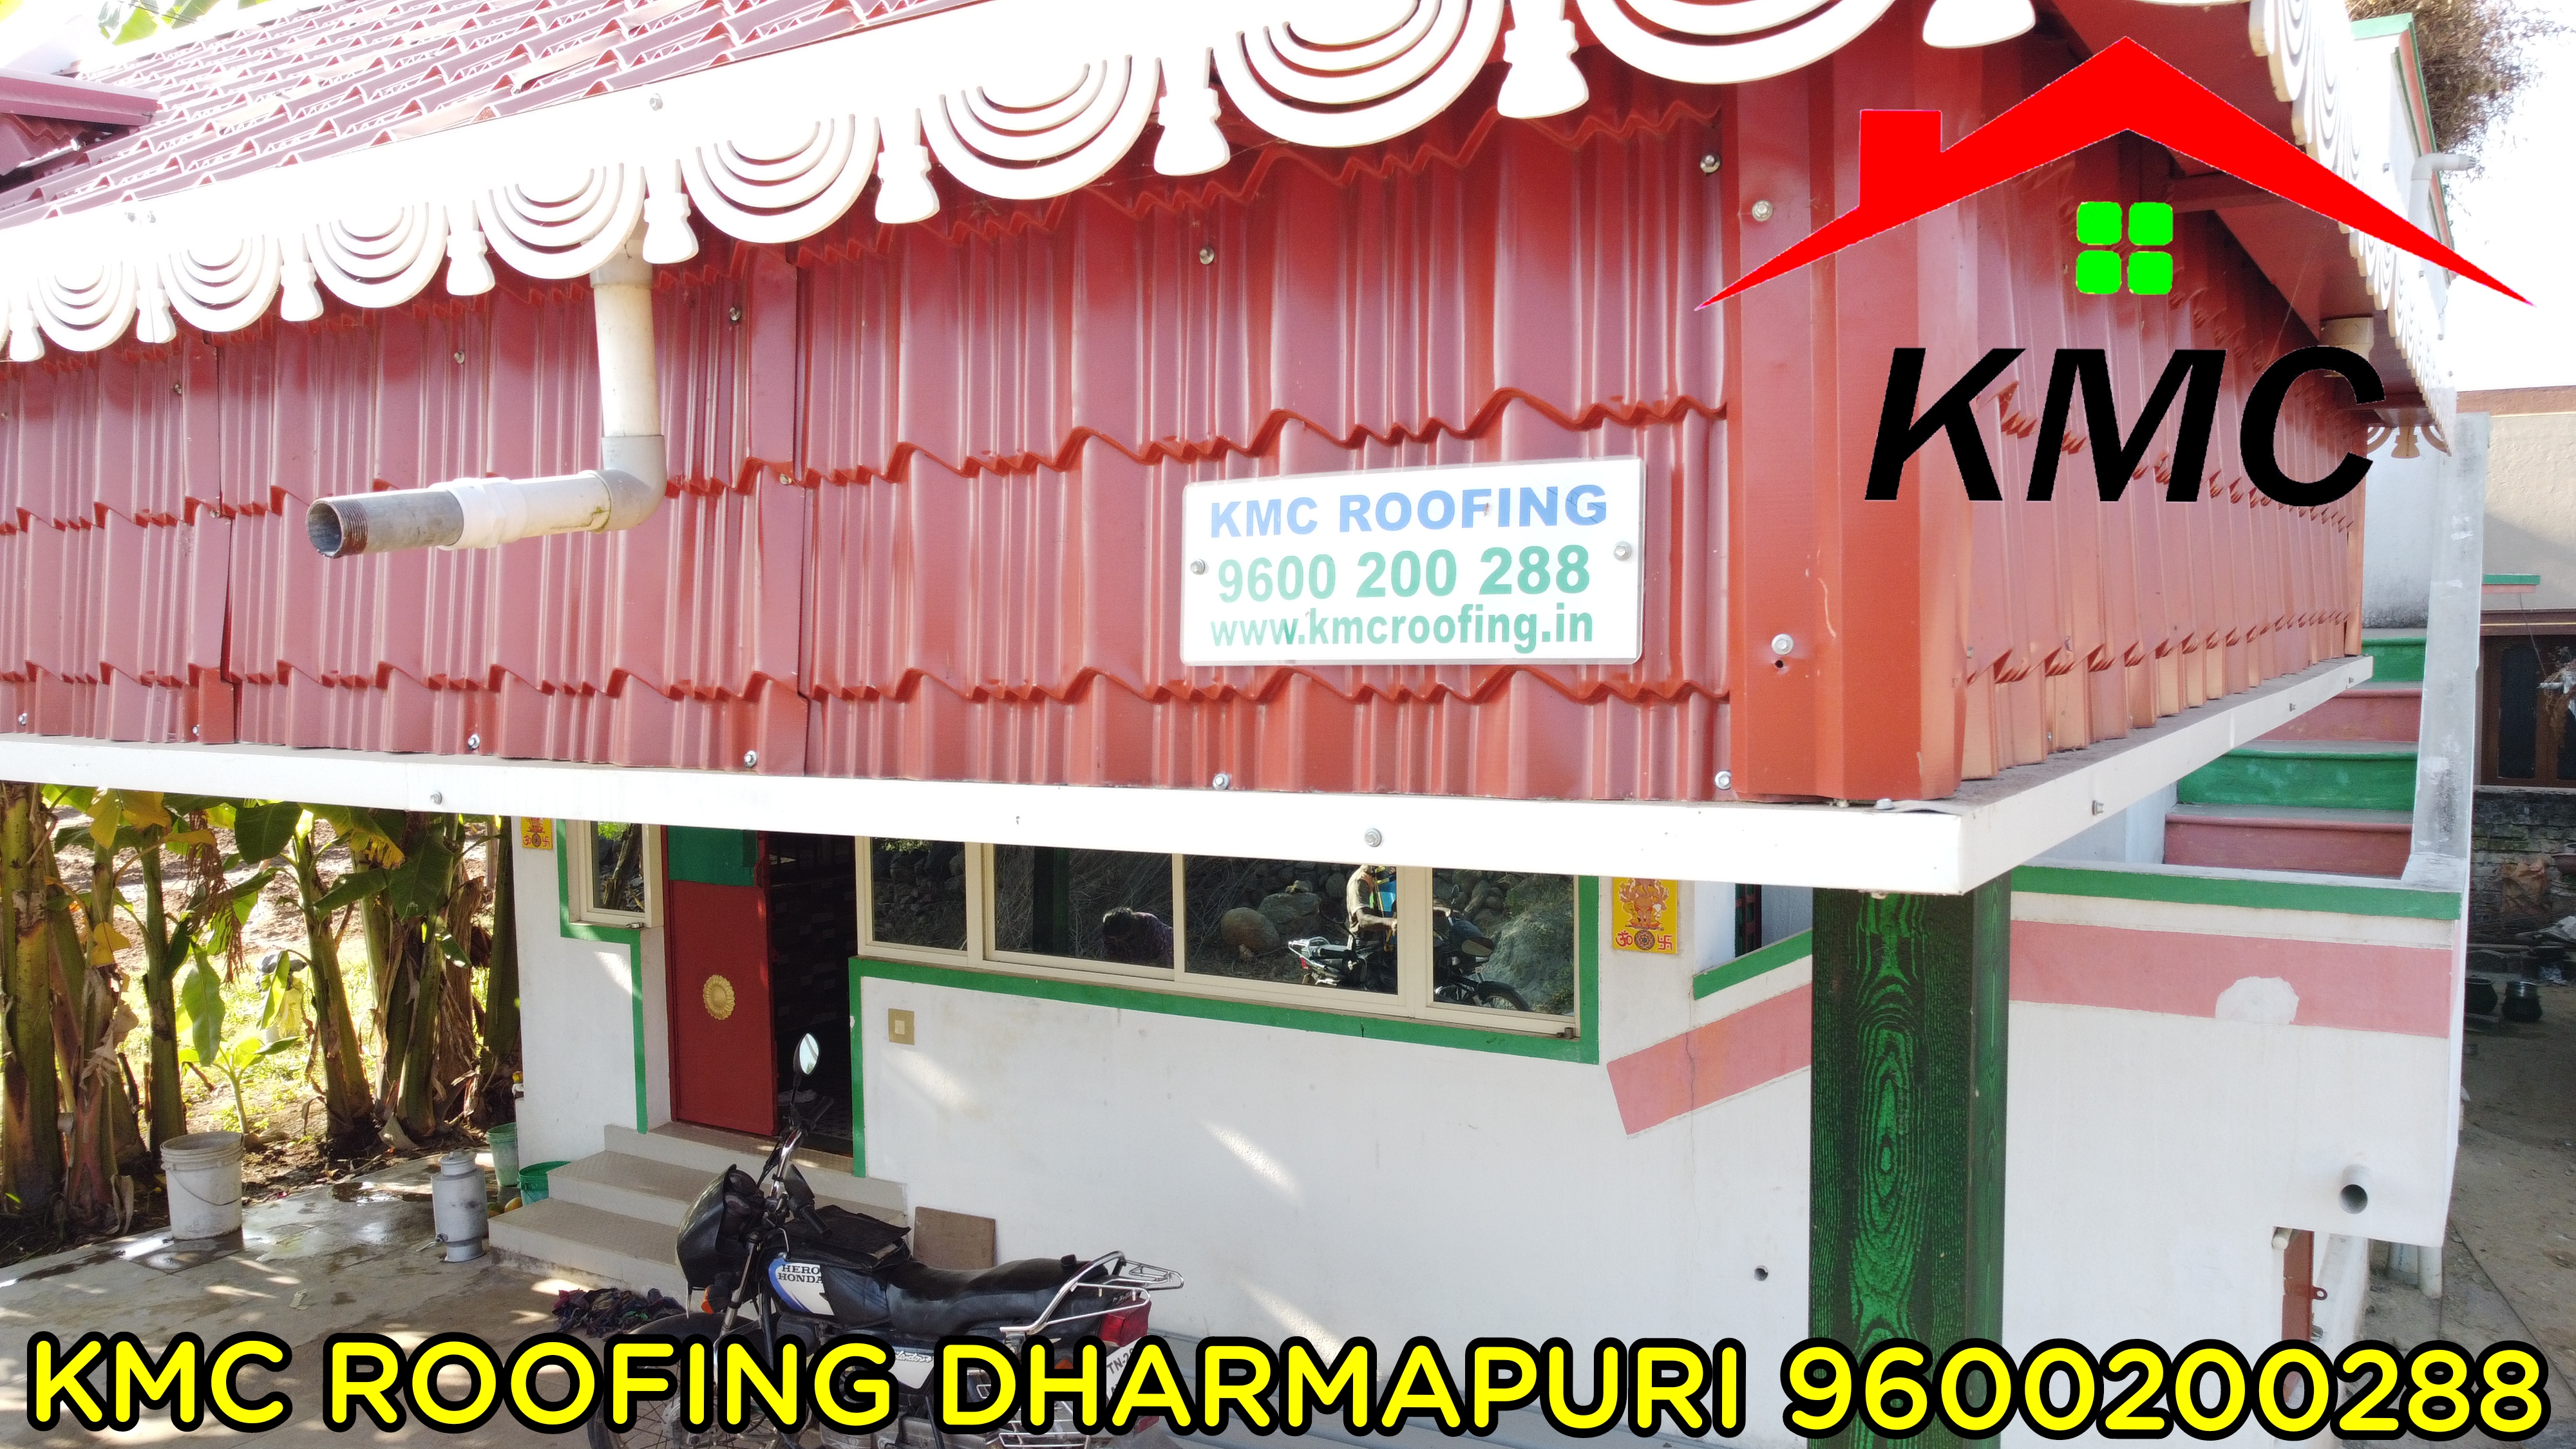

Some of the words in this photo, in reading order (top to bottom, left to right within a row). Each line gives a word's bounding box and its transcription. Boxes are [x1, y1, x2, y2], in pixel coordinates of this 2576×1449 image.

[1211, 497, 1318, 538] KMC
[1339, 484, 1607, 533] ROOFING
[1218, 553, 1336, 603] 9600
[1356, 548, 1457, 598] 200
[1479, 544, 1591, 596] 288
[1210, 601, 1594, 655] www.kmcroofing.in
[778, 1273, 823, 1283] HONDA
[782, 1264, 820, 1275] HERO
